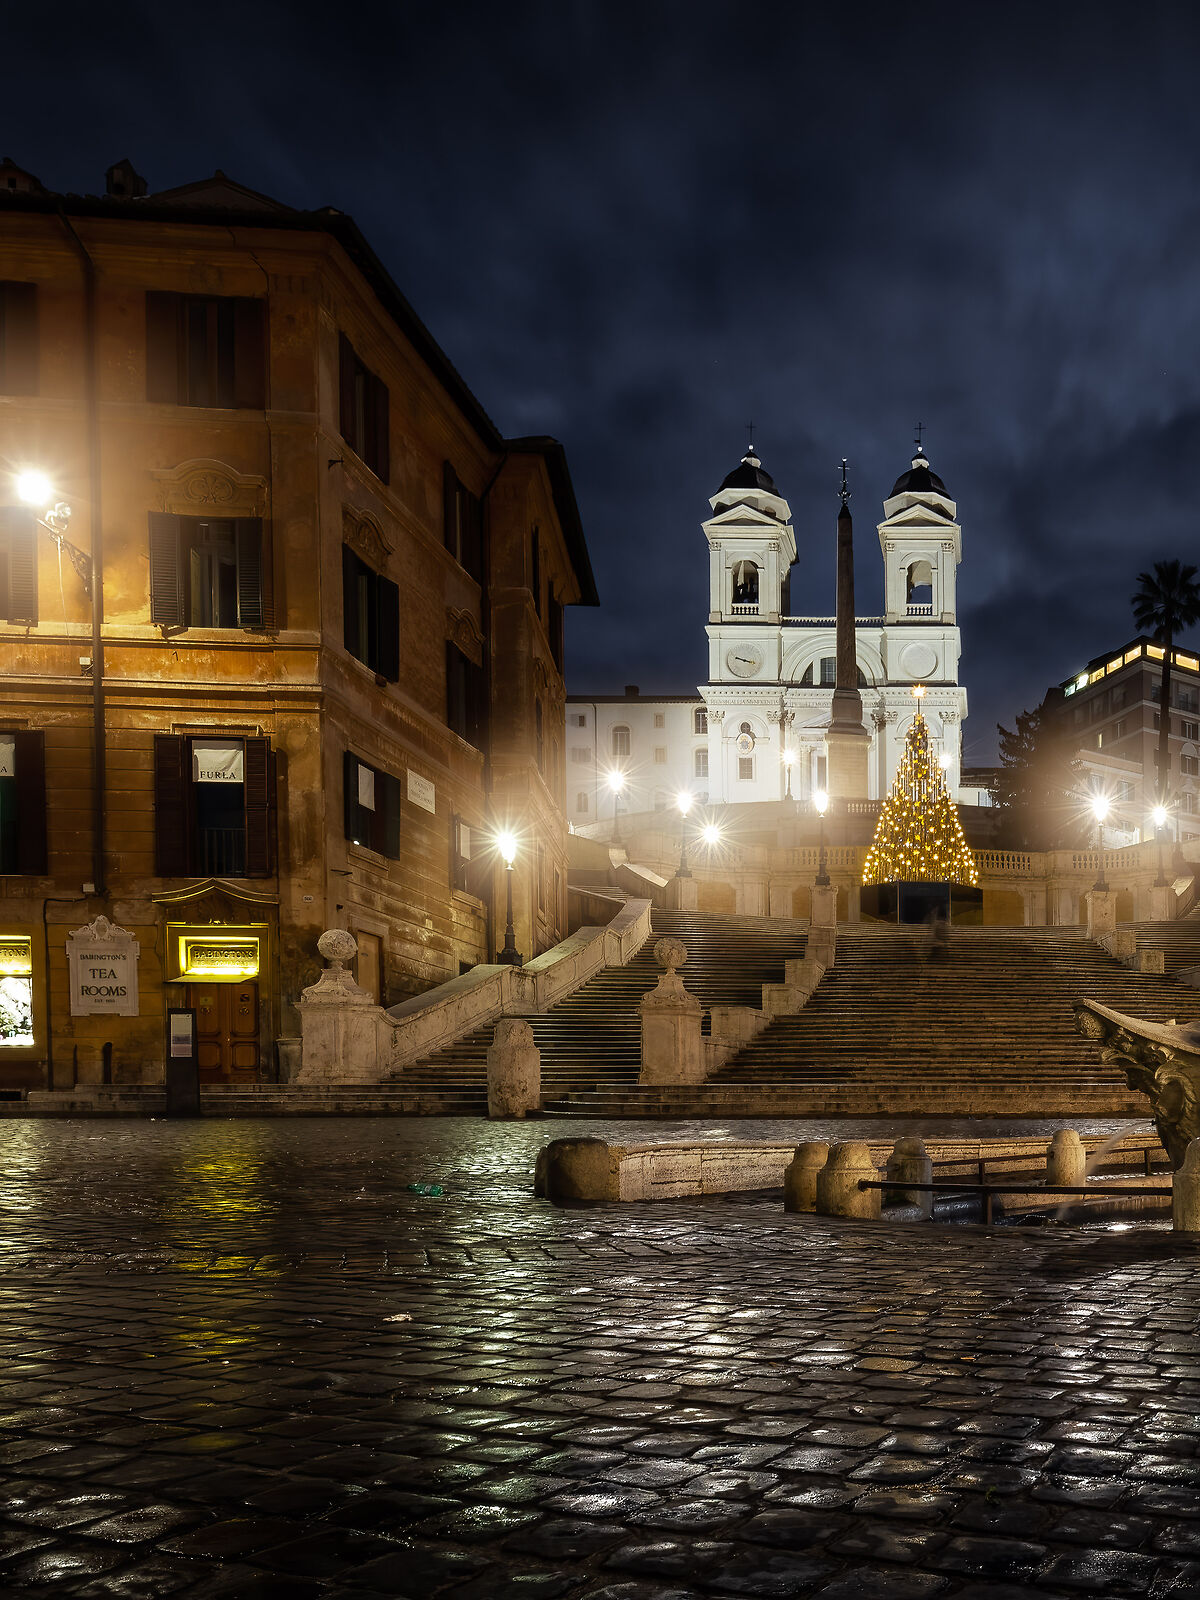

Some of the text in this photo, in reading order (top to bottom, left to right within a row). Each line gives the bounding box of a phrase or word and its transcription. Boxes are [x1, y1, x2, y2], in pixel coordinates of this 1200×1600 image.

[200, 770, 236, 779] FURLA
[80, 953, 127, 961] BABINGTON'S
[88, 968, 118, 979] TEA
[81, 985, 127, 997] ROOMS
